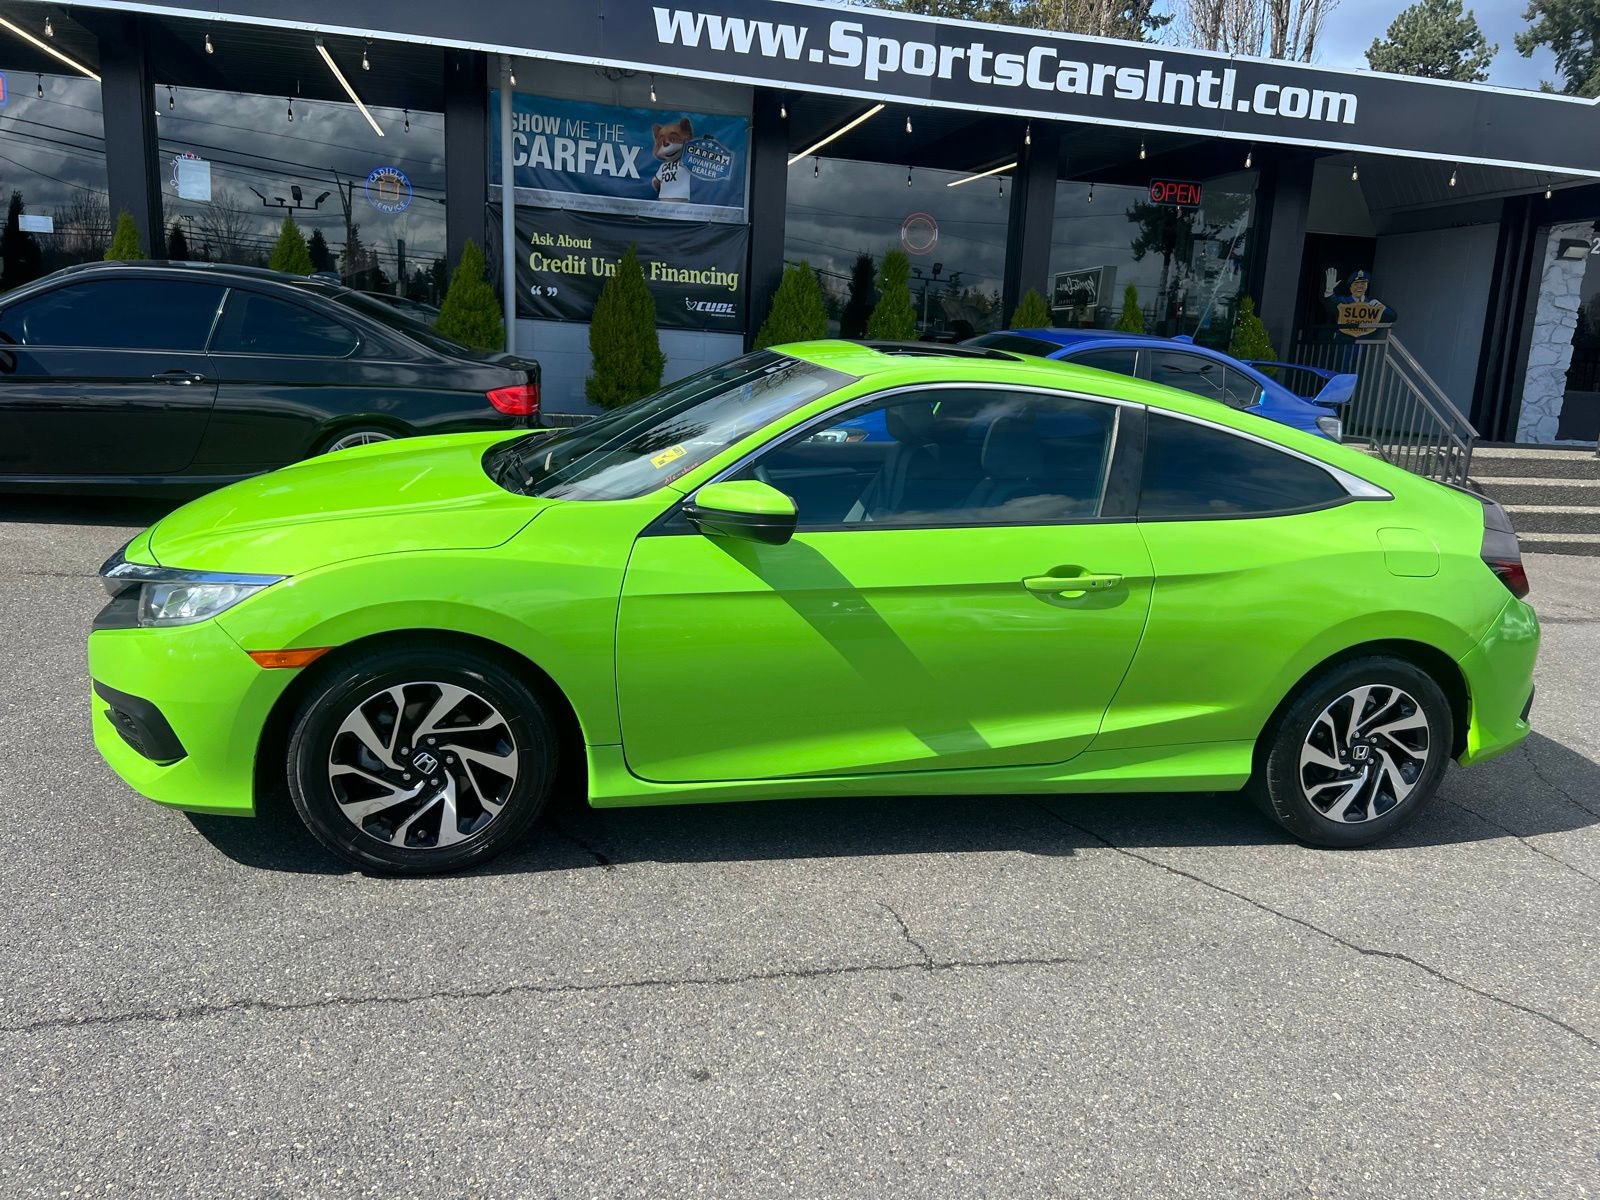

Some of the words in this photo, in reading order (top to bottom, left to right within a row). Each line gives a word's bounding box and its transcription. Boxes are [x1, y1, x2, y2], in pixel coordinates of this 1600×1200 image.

[653, 6, 1357, 125] www.SportsCarsIntl.com
[565, 119, 591, 139] ME
[595, 122, 625, 143] THE
[512, 131, 640, 179] CARFAX
[687, 146, 730, 165] CARFAX
[662, 161, 679, 172] CAR
[688, 156, 725, 173] ADVANTAGE
[692, 166, 717, 178] DEALER
[662, 171, 677, 182] FOX
[1151, 182, 1201, 204] OPEN
[531, 232, 554, 246] Ask
[556, 234, 592, 249] About
[529, 252, 587, 275] Credit
[650, 262, 739, 291] Financing
[1344, 307, 1380, 319] SLOW
